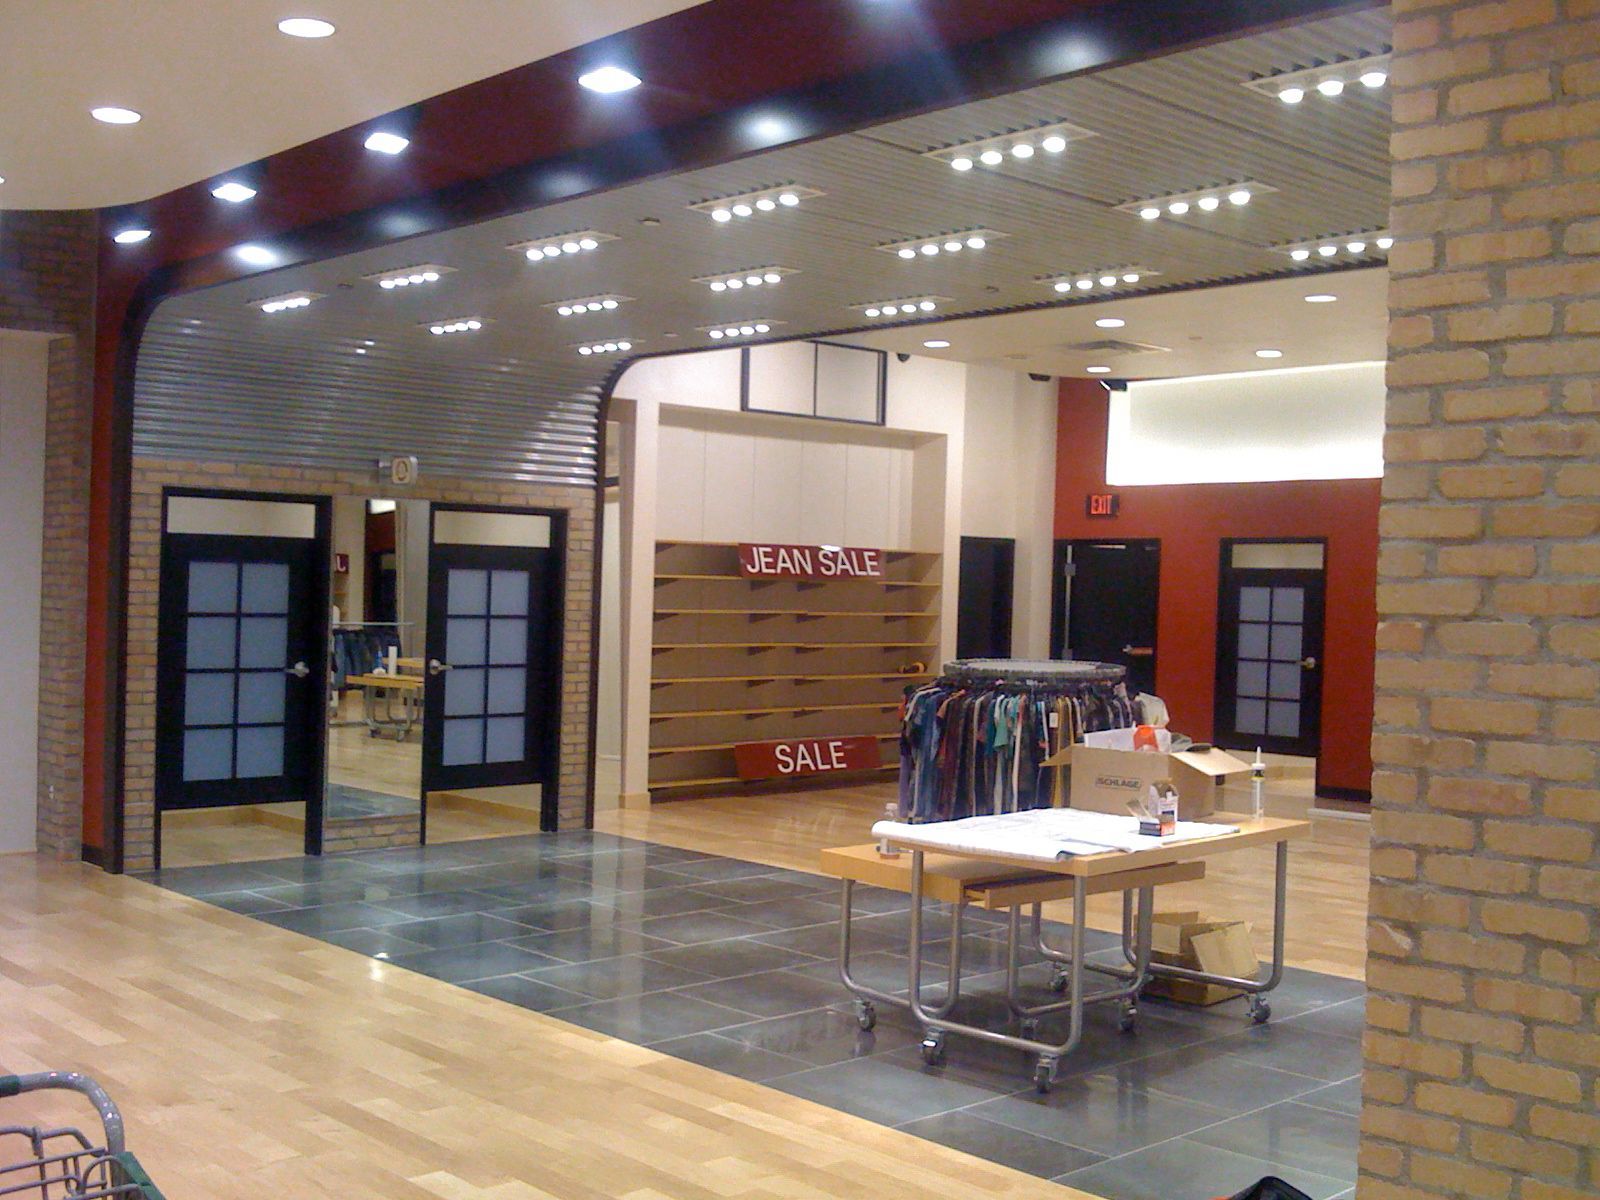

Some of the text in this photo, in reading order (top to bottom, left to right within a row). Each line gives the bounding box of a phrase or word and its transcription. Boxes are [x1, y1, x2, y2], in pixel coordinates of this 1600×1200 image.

[1091, 494, 1112, 515] EXIT
[747, 547, 881, 576] JEAN SALE
[775, 741, 847, 774] SALE
[1097, 777, 1140, 788] SCHLAGE
